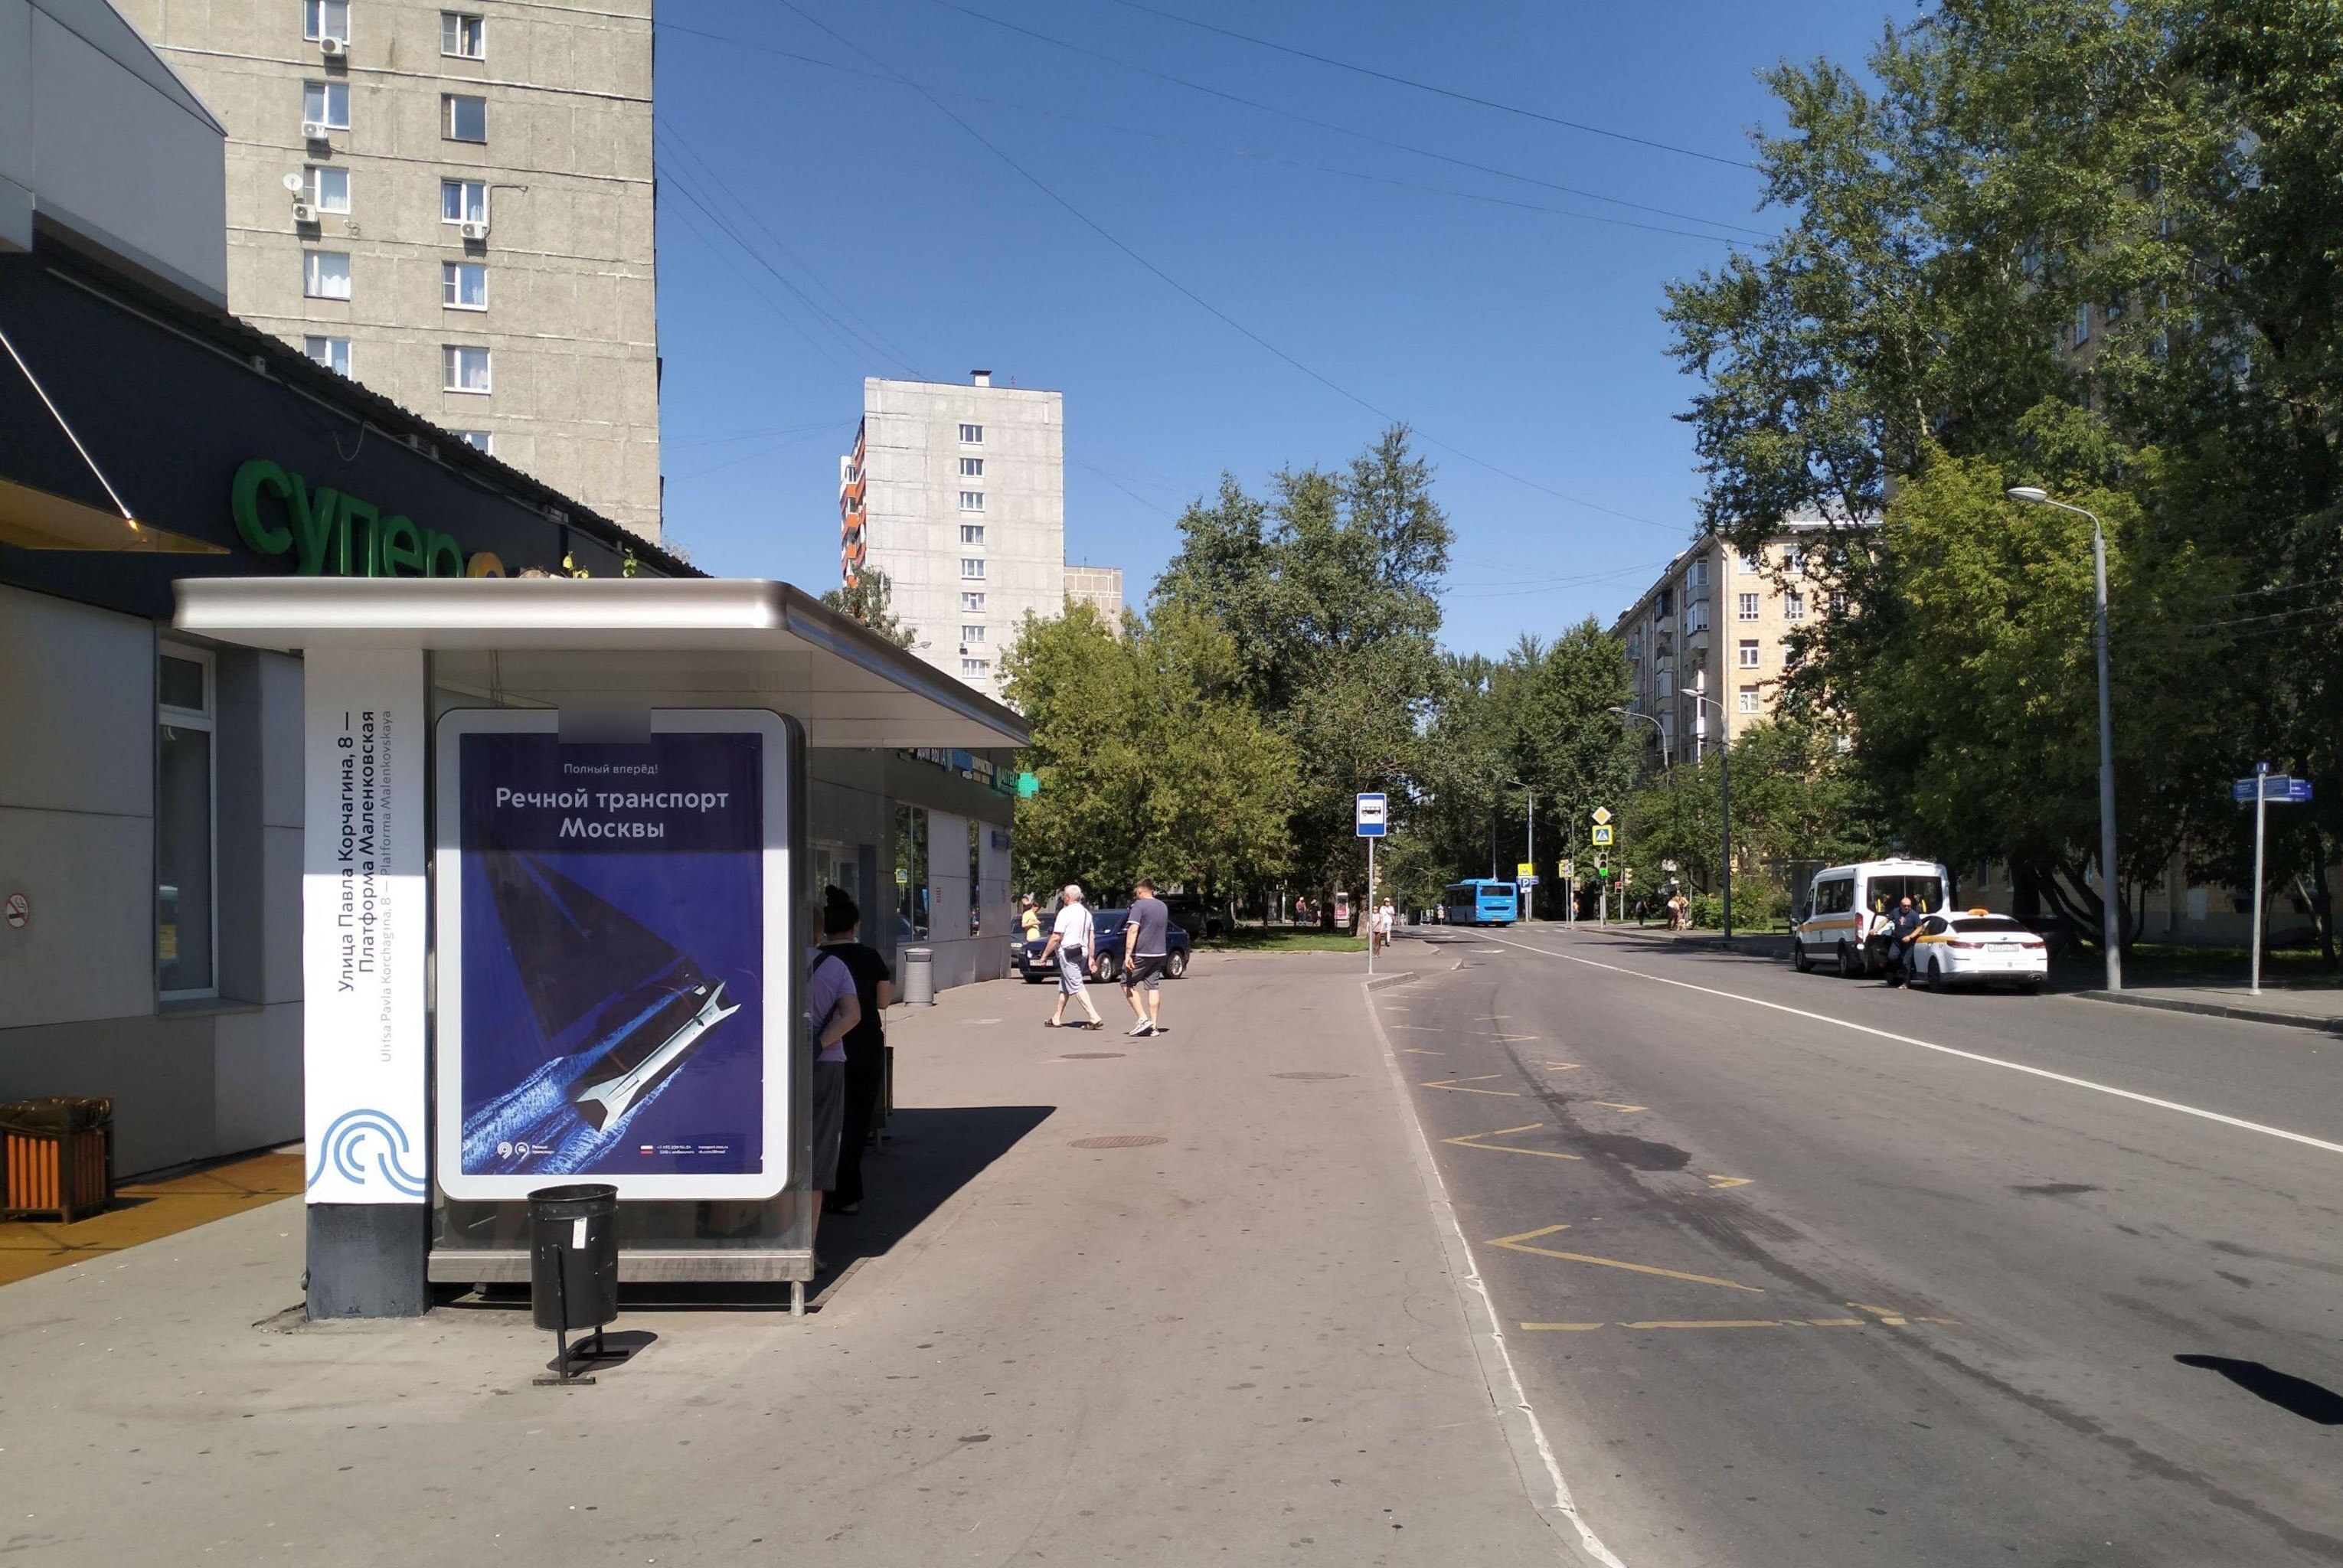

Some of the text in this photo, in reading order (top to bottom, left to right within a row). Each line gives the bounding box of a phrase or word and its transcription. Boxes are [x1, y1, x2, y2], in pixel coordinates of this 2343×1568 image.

[338, 737, 354, 749] 8
[380, 710, 394, 810] Malenkovskaya
[564, 763, 658, 776] Полный вперёд!
[338, 754, 357, 861] Корчагина,
[496, 787, 729, 812] Речной транспорт
[358, 711, 377, 972] Платформа Маленковская
[380, 813, 391, 876] Platforma
[559, 817, 665, 838] Москвы
[338, 867, 354, 927] Павла
[381, 897, 391, 906] 8
[338, 934, 355, 992] Улица
[381, 908, 394, 985] Korchagina,
[381, 988, 391, 1021] Pavla
[381, 1024, 391, 1063] Ulitsa
